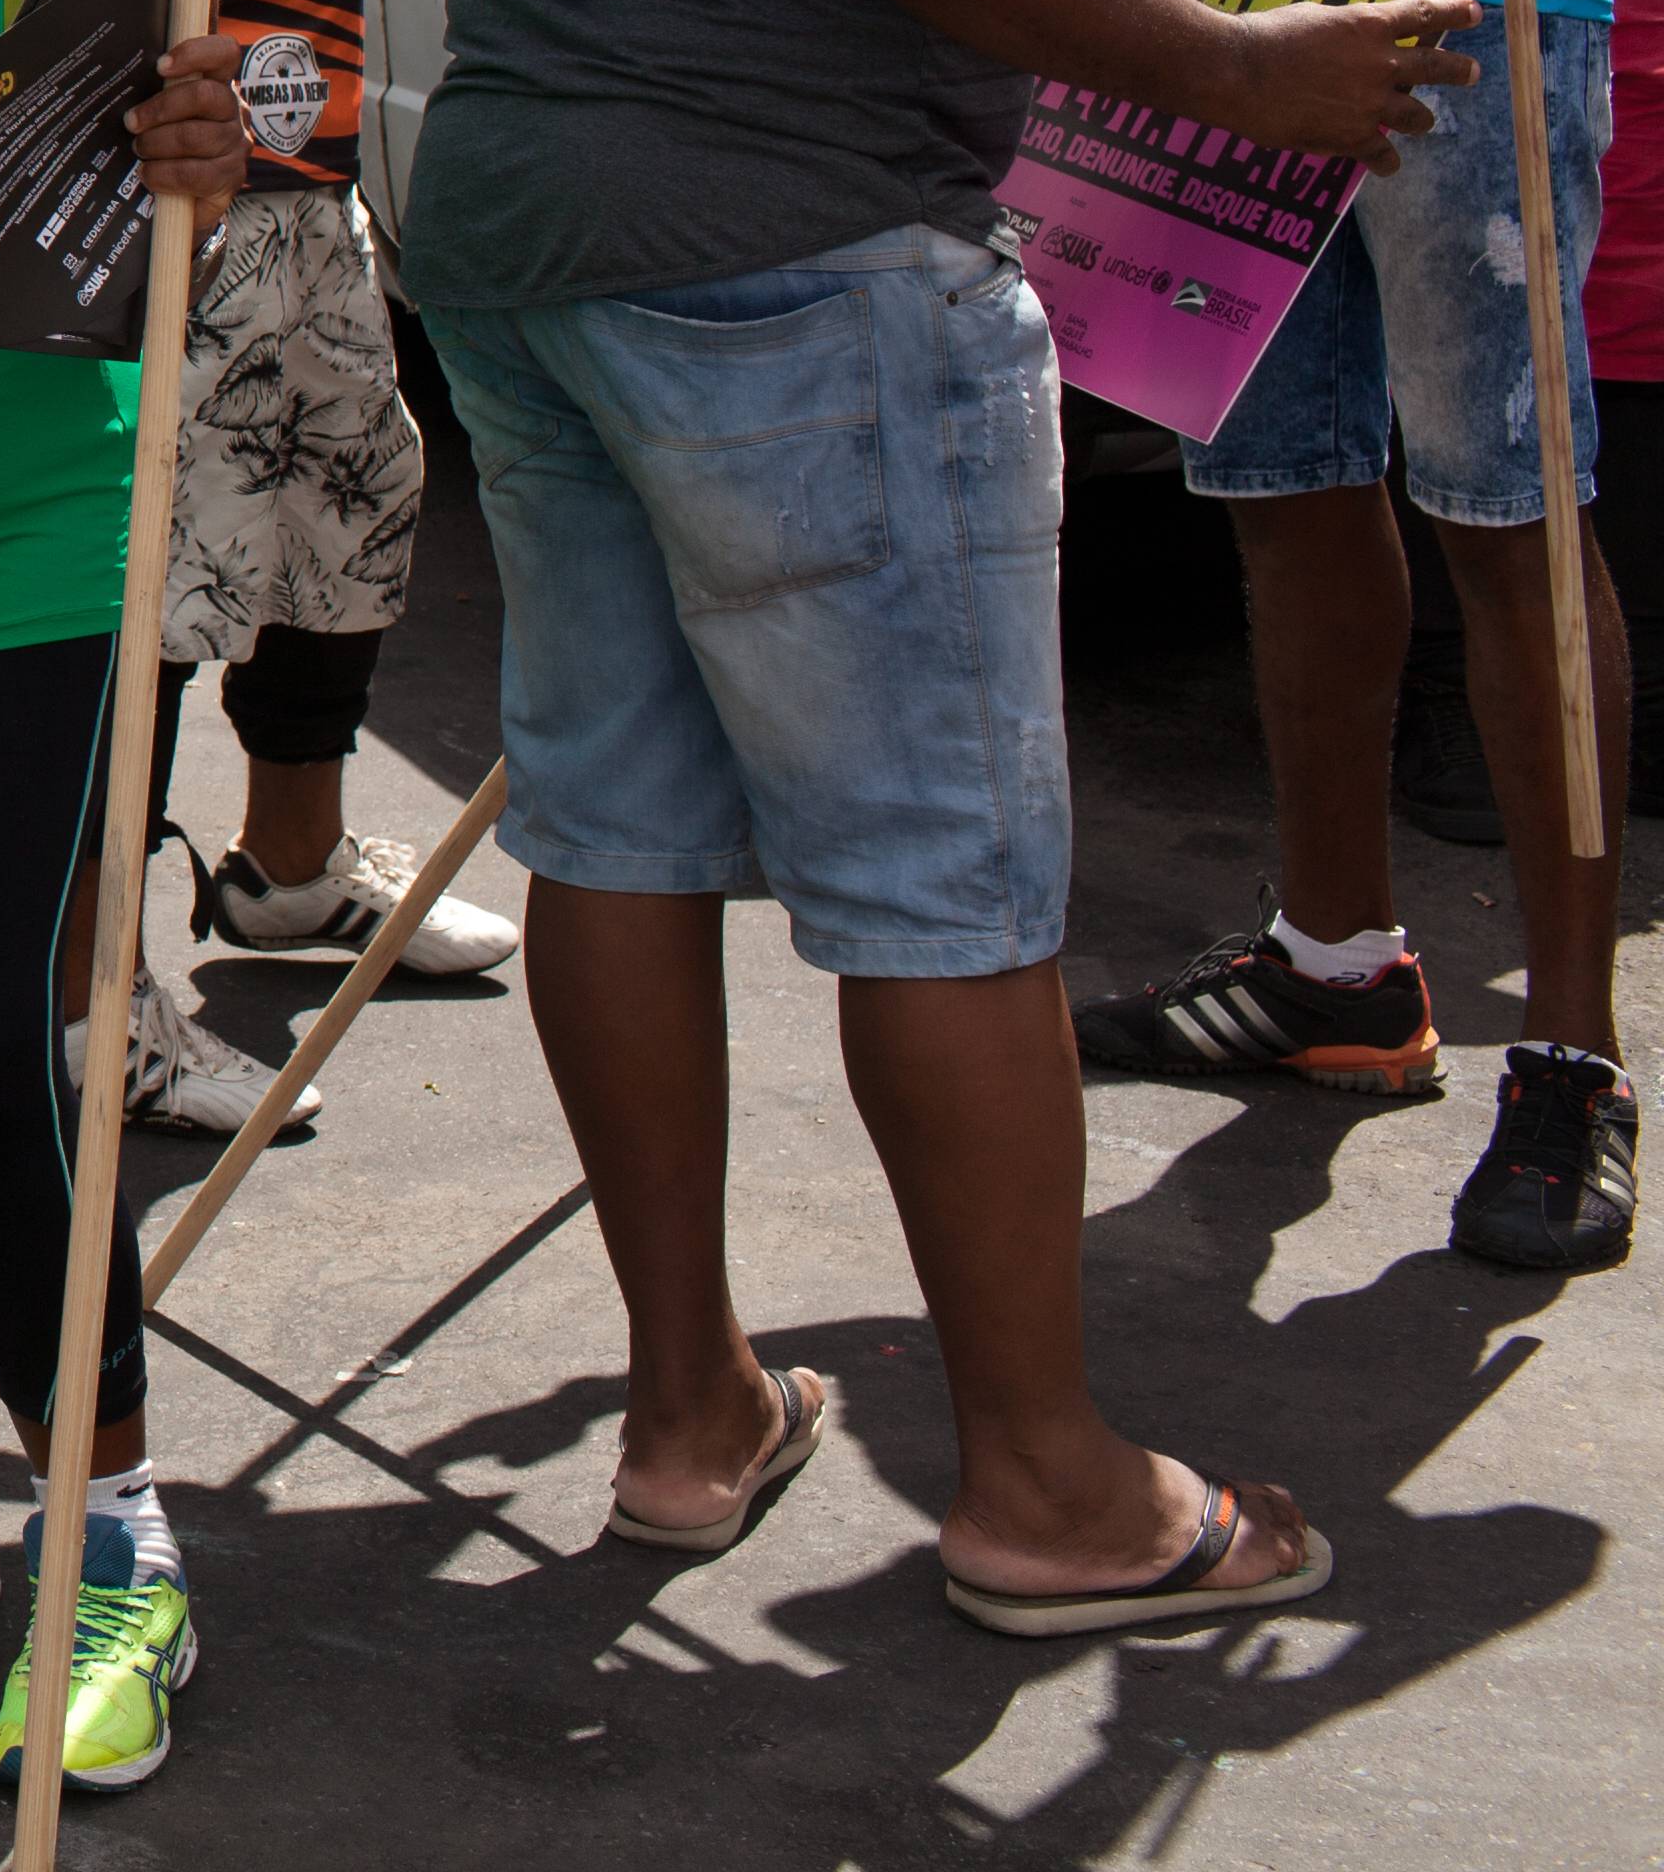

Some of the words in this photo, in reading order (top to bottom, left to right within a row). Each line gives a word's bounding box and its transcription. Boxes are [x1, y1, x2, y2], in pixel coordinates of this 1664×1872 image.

[241, 84, 289, 107] AMISAS
[1064, 133, 1178, 201] DENUNCIE.
[1179, 177, 1264, 230] DISQUE
[1263, 208, 1314, 252] 100.
[82, 199, 120, 249] CEDECA-BA
[1010, 214, 1040, 235] PLAN
[106, 228, 130, 265] unicef
[1060, 232, 1104, 272] SUAS
[1102, 253, 1154, 288] unicef
[1203, 297, 1254, 330] BRASIL
